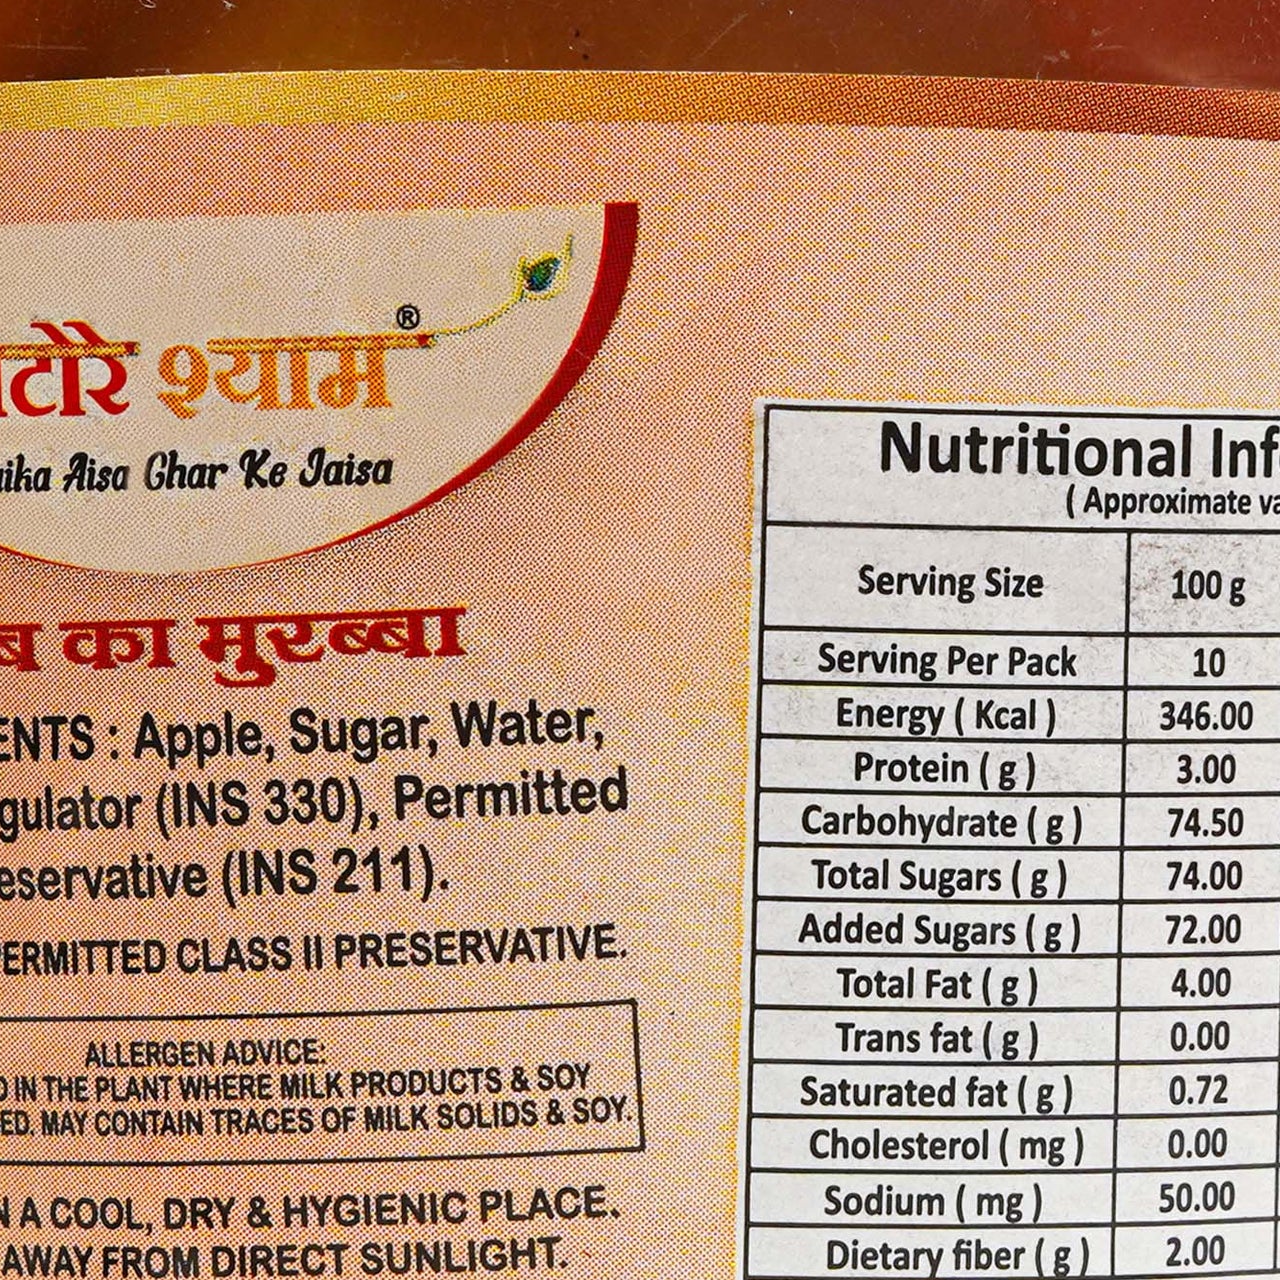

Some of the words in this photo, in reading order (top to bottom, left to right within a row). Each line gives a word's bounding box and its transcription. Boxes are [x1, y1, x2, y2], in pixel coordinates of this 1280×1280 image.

[158, 329, 435, 420] श्याम
[881, 421, 1191, 477] Nutritional
[64, 452, 129, 492] Aisa
[239, 449, 287, 488] Ke
[299, 447, 393, 487] Jaisa
[1083, 487, 1251, 519] Approximate
[859, 564, 975, 604] Serving
[985, 567, 1043, 598] Size
[1173, 570, 1222, 600] 100
[1230, 578, 1245, 607] g
[61, 615, 176, 674] का
[197, 601, 472, 689] मुरब्बा
[818, 642, 939, 681] Serving
[948, 646, 998, 675] Per
[1009, 646, 1076, 676] Pack
[1194, 648, 1225, 677] 10
[836, 697, 947, 734] Energy
[1161, 701, 1253, 730] 346.00
[134, 711, 274, 769] Apple,
[290, 708, 437, 764] Sugar,
[451, 699, 603, 749] Water,
[855, 752, 968, 782] Protein
[1178, 754, 1236, 784] 3.00
[156, 780, 249, 839] (INS
[264, 777, 378, 833] 330),
[394, 766, 627, 820] Permitted
[800, 804, 1020, 842] Carbohydrate
[1168, 808, 1244, 837] 74.50
[223, 848, 317, 908] (INS
[332, 845, 448, 901] 211).
[812, 859, 889, 890] Total
[897, 860, 1003, 899] Sugars
[1167, 861, 1242, 890] 74.00
[799, 913, 903, 944] Added
[912, 915, 1018, 949] Sugars
[1166, 914, 1241, 944] 72.00
[177, 936, 292, 974] CLASS
[304, 935, 323, 969] II
[334, 923, 629, 968] PRESERVATIVE.
[837, 968, 914, 998] Total
[926, 969, 972, 999] Fat
[1172, 967, 1231, 997] 4.00
[85, 1041, 215, 1068] ALLERGEN
[222, 1038, 328, 1066] ADVICE:
[836, 1022, 920, 1053] Trans
[930, 1022, 972, 1053] fat
[1171, 1021, 1230, 1052] 0.00
[15, 1077, 37, 1100] IN
[43, 1075, 88, 1102] THE
[96, 1075, 172, 1102] PLANT
[179, 1074, 272, 1100] WHERE
[280, 1073, 343, 1099] MILK
[351, 1067, 502, 1097] PRODUCTS
[537, 1063, 590, 1091] SOY
[801, 1076, 956, 1107] Saturated
[966, 1076, 1007, 1107] fat
[1169, 1074, 1227, 1105] 0.72
[41, 1111, 87, 1135] MAY
[95, 1110, 203, 1136] CONTAIN
[211, 1107, 314, 1134] TRACES
[321, 1106, 355, 1133] OF
[364, 1105, 428, 1131] MILK
[437, 1100, 538, 1130] SOLIDS
[573, 1096, 634, 1124] SOY.
[810, 1128, 988, 1160] Cholesterol
[1168, 1128, 1227, 1159] 0.00
[20, 1197, 41, 1228] A
[50, 1197, 152, 1233] COOL,
[164, 1197, 234, 1229] DRY
[283, 1192, 467, 1227] HYGIENIC
[479, 1185, 619, 1222] PLACE.
[825, 1185, 944, 1215] Sodium
[1160, 1181, 1235, 1213] 50.00
[2, 1245, 93, 1277] AWAY
[103, 1246, 199, 1279] FROM
[211, 1244, 349, 1277] DIRECT
[361, 1236, 569, 1275] SUNLIGHT.
[826, 1240, 947, 1277] Dietary
[953, 1239, 1025, 1270] fiber
[1166, 1235, 1225, 1267] 2.00
